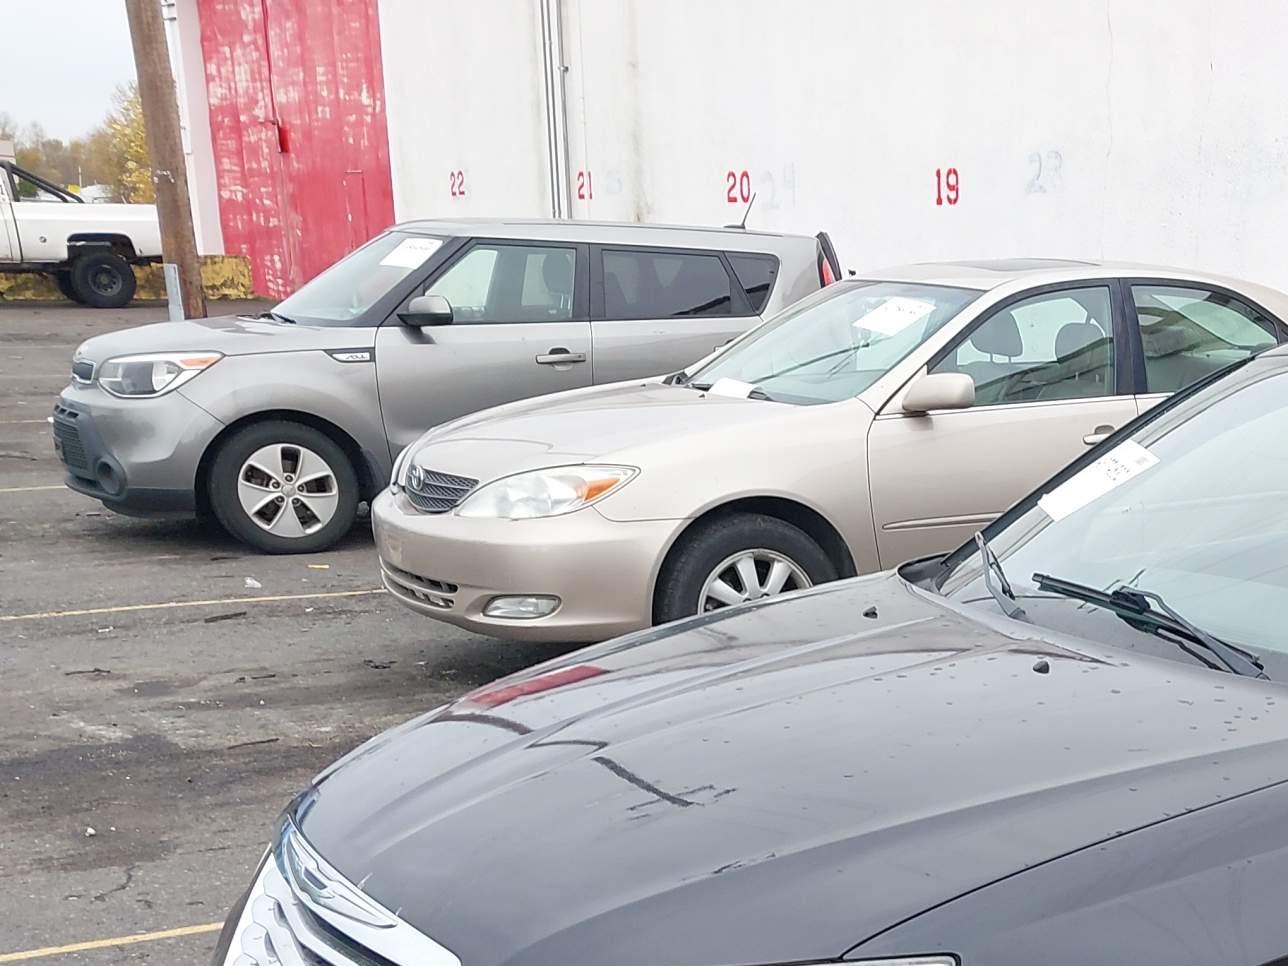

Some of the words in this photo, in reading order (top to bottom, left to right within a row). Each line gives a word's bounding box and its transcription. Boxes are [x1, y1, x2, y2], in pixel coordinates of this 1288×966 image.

[450, 171, 465, 197] 22
[576, 171, 593, 200] 21
[726, 170, 751, 205] 20
[936, 168, 959, 206] 19
